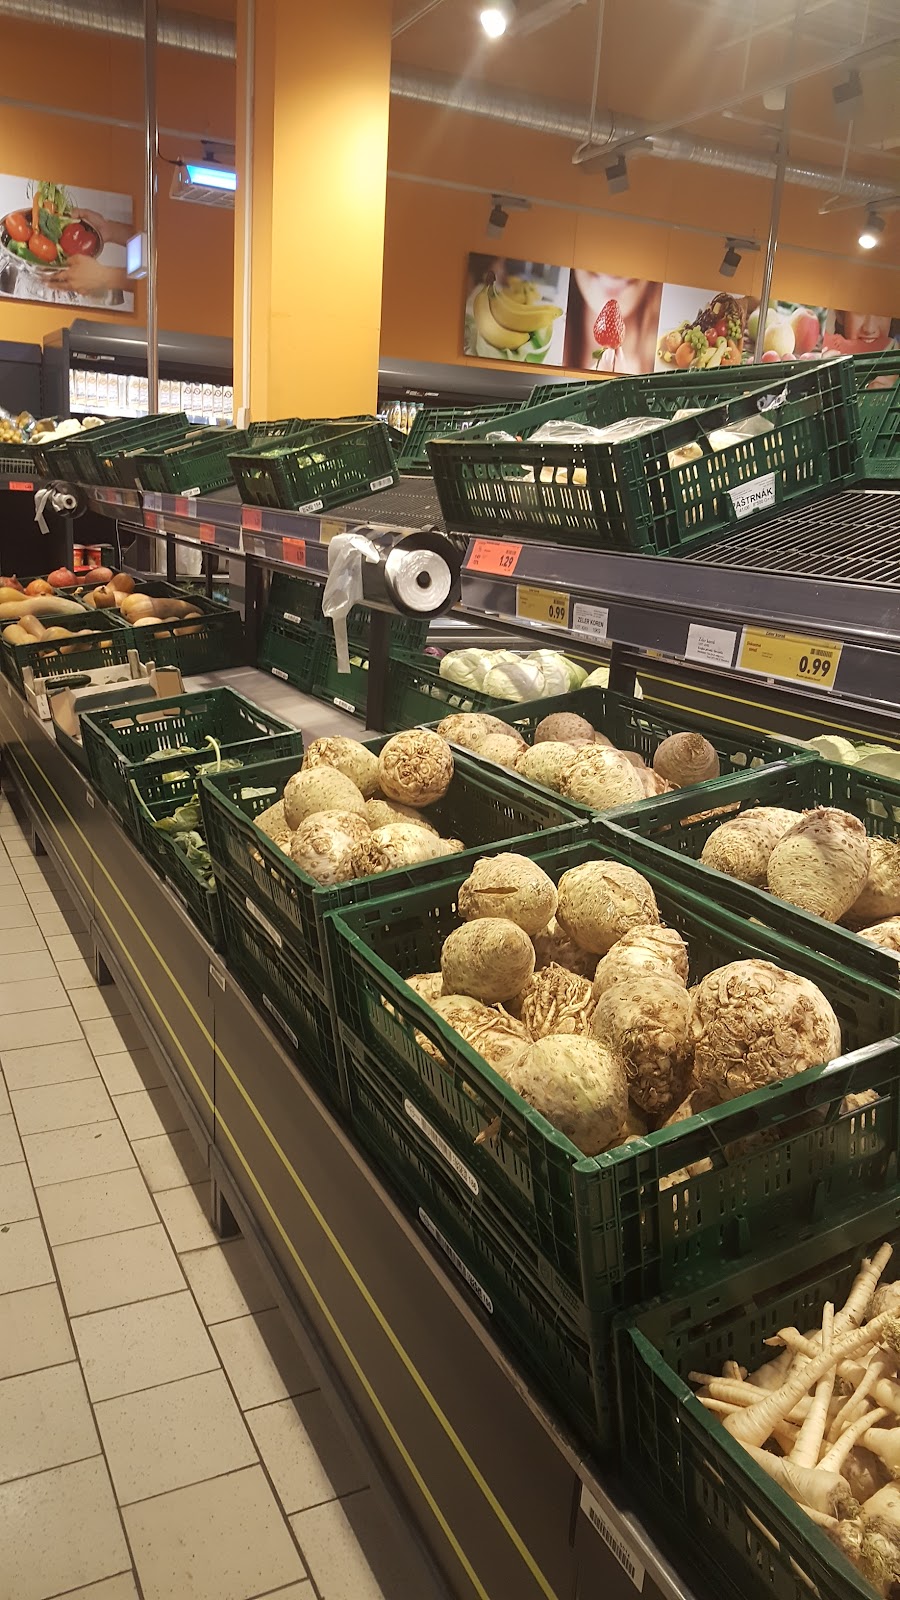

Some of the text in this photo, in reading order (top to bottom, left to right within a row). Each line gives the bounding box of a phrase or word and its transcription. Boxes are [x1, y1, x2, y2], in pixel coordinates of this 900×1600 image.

[499, 554, 514, 568] 1.29
[548, 604, 565, 620] 0.99
[799, 656, 831, 677] 0.99
